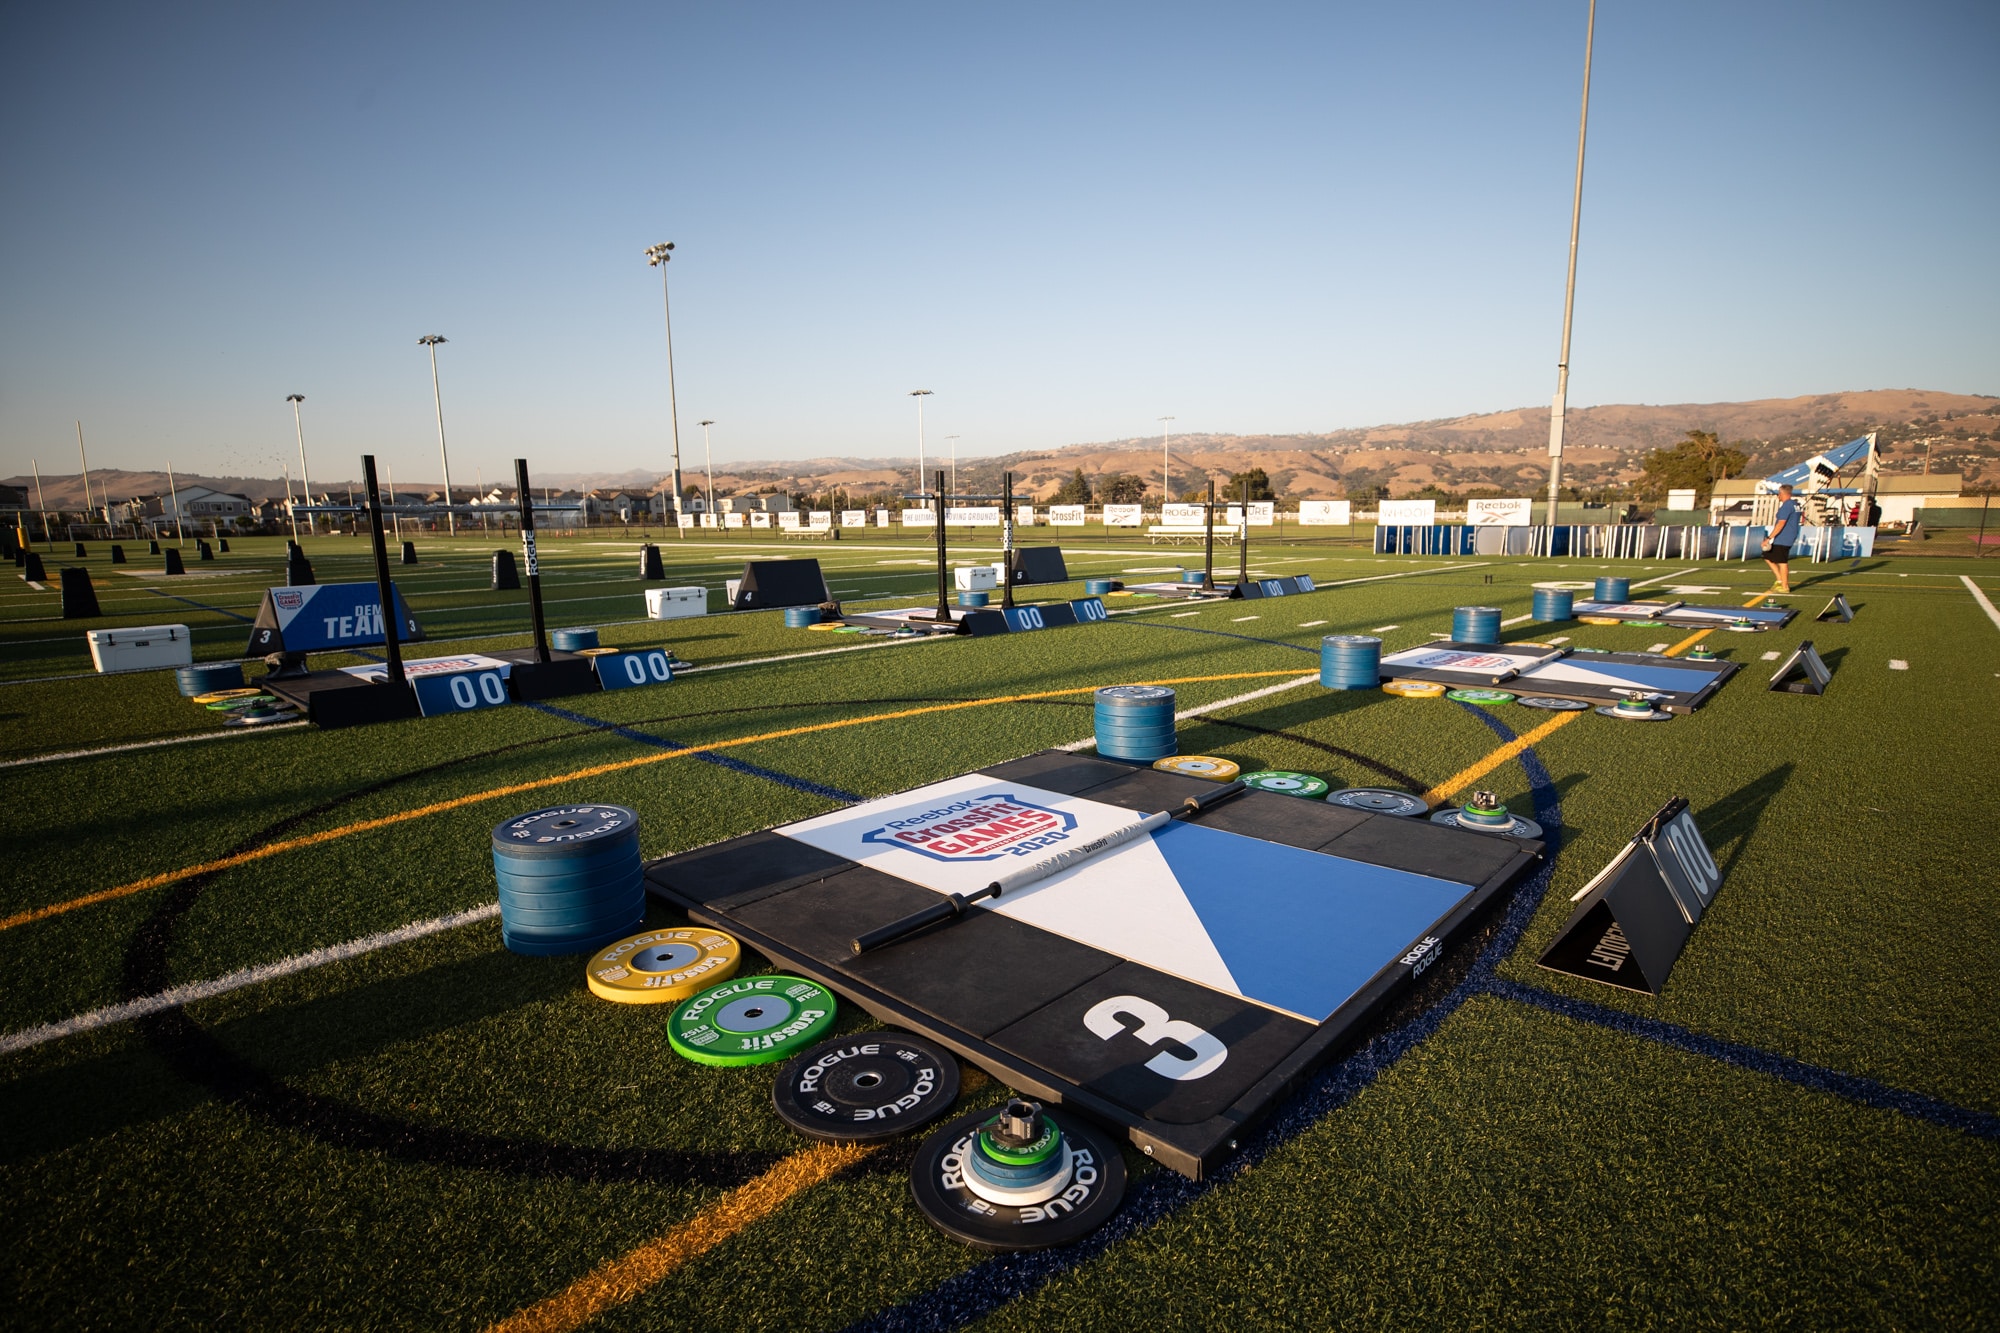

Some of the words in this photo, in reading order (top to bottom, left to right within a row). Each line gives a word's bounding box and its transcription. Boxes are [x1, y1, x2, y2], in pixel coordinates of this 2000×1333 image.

[915, 513, 935, 522] ULTIMA
[968, 512, 997, 521] GROUNDS
[1051, 510, 1081, 521] CrossFit
[1249, 507, 1269, 515] URE
[1477, 501, 1521, 510] Reebok
[810, 515, 829, 524] CrossFit
[526, 530, 539, 576] ROGUE
[1016, 571, 1023, 580] 5
[1268, 580, 1284, 596] 00
[744, 592, 753, 601] 4
[355, 604, 383, 617] DEM
[1018, 608, 1044, 629] 00
[1083, 600, 1107, 620] 00
[260, 630, 271, 644] 3
[409, 619, 416, 632] 3
[624, 652, 670, 684] 00
[450, 672, 505, 708] 00
[511, 807, 594, 828] ROGUE
[885, 800, 979, 830] Reebok
[895, 803, 1024, 844] CrossFit
[536, 820, 622, 843] ROGUE
[926, 809, 1053, 854] GAMES
[1002, 831, 1070, 856] 2020
[1083, 838, 1108, 853] CrossFit
[1670, 813, 1718, 895] 00
[603, 931, 694, 961] ROGUE
[1399, 936, 1439, 965] ROGUE
[644, 956, 727, 987] CrossFit
[1413, 942, 1442, 979] ROGUE
[682, 980, 775, 1021] ROGUE
[742, 1009, 826, 1050] CrossFit
[1083, 995, 1228, 1081] 3
[800, 1044, 880, 1093] ROGUE
[854, 1067, 935, 1121] ROGUE
[1019, 1149, 1097, 1223] ROGUE
[967, 1199, 991, 1214] 10
[986, 1208, 997, 1217] LB
